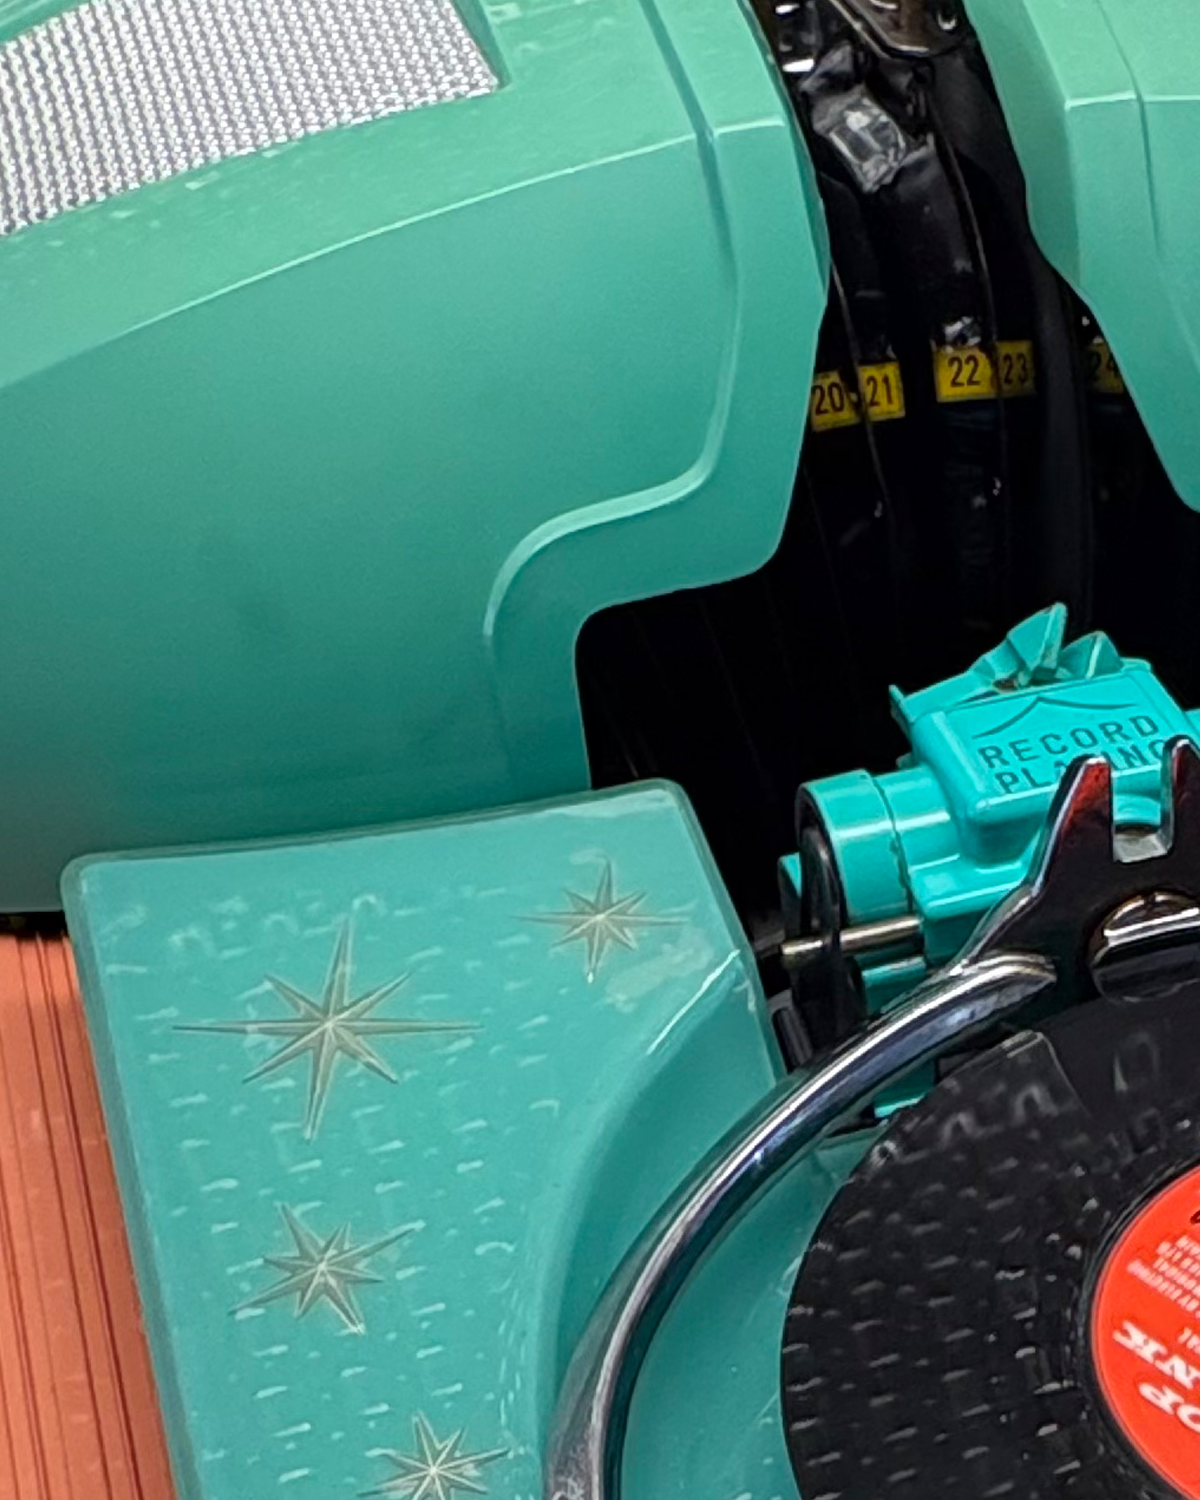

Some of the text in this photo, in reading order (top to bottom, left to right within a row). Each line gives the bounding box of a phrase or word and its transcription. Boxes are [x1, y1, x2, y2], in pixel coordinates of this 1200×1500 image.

[947, 355, 981, 388] 22
[1003, 356, 1029, 386] 23
[813, 383, 845, 415] 20
[866, 374, 893, 408] 21
[977, 714, 1160, 769] RECORD
